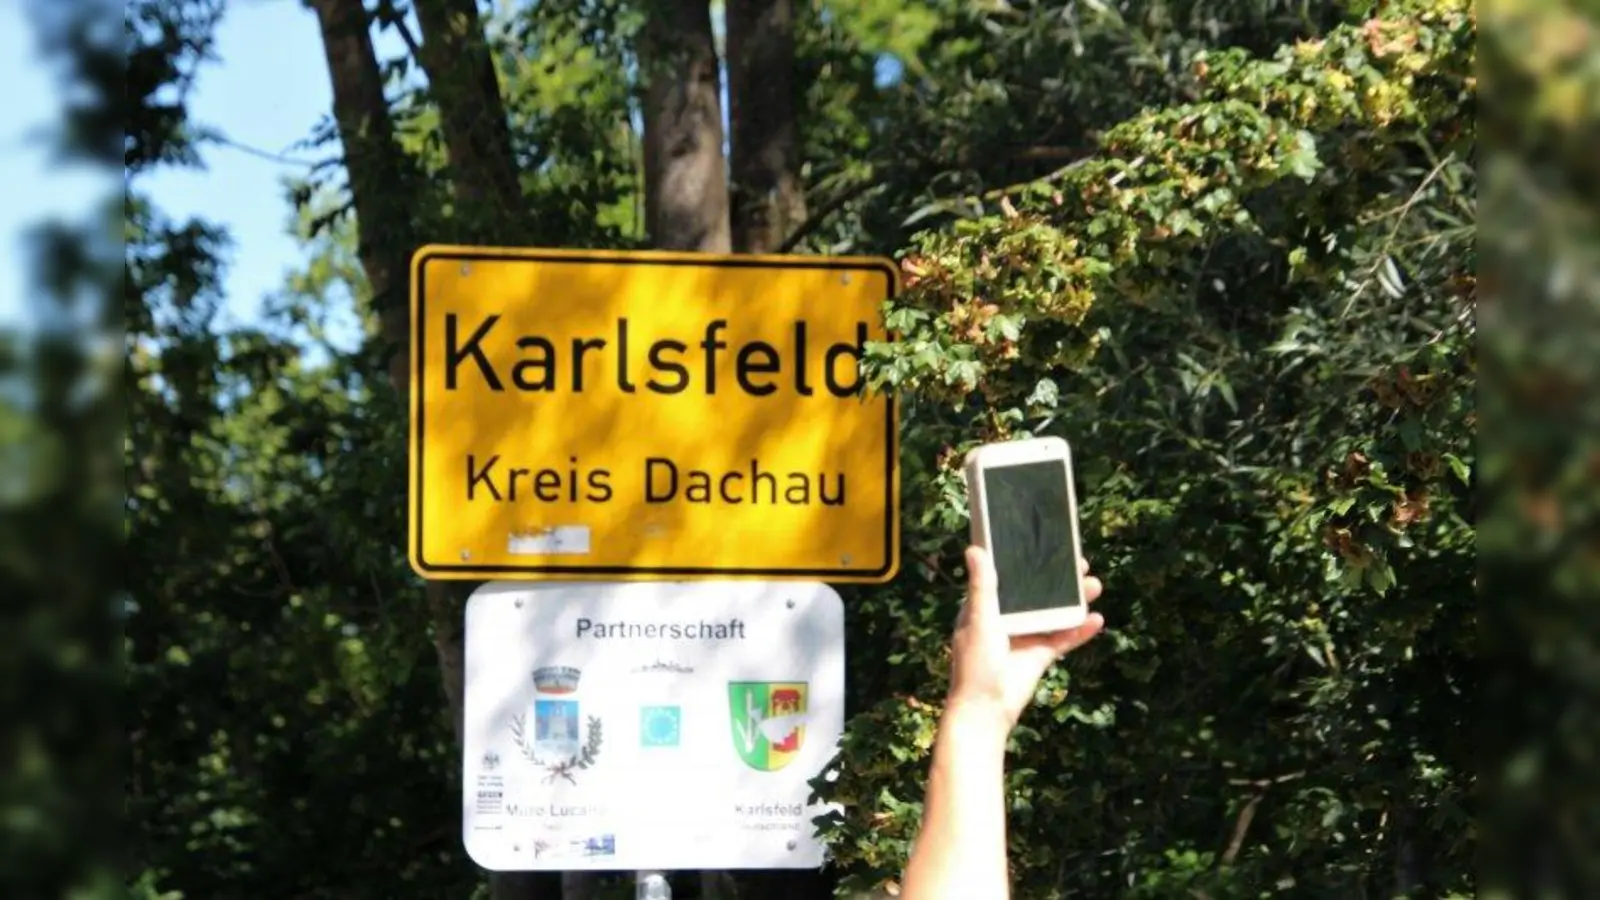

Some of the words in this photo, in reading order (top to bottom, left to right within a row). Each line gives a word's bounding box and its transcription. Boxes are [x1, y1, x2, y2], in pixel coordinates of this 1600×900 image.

[444, 313, 868, 398] Karlsfeld
[466, 455, 613, 502] Kreis
[645, 458, 846, 506] Dachau
[575, 617, 746, 640] Partnerschaft
[550, 803, 608, 817] Lucan
[735, 802, 803, 817] Karlsfeld
